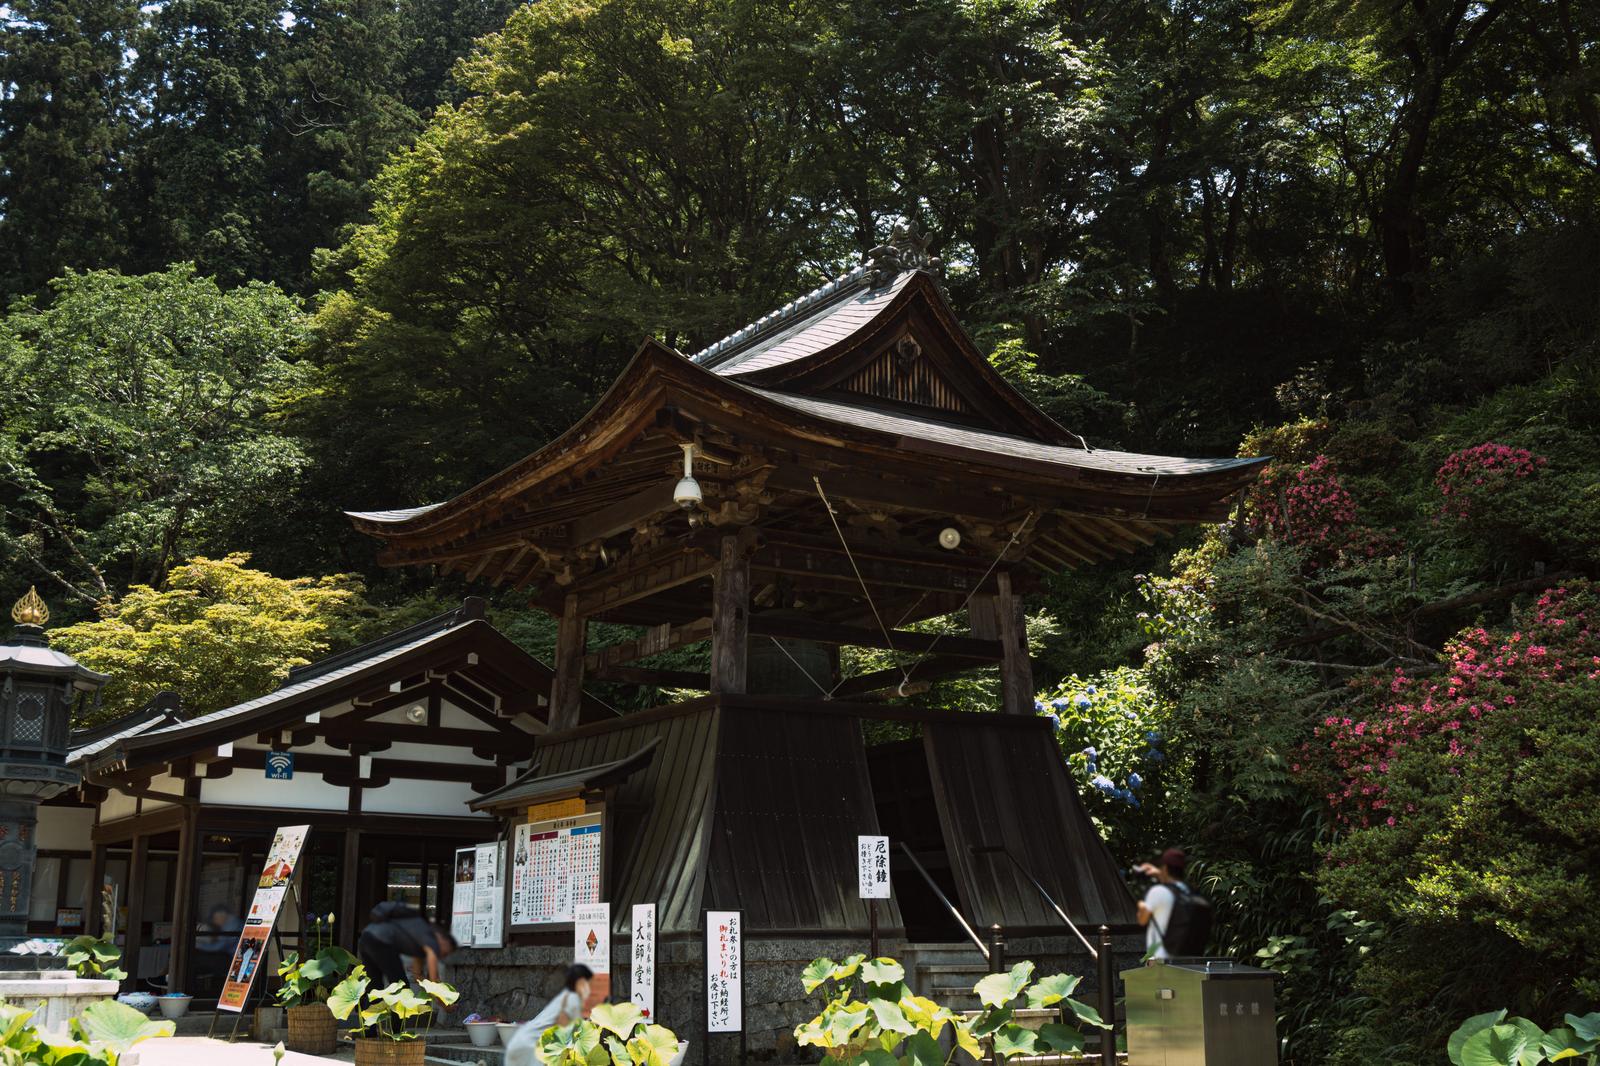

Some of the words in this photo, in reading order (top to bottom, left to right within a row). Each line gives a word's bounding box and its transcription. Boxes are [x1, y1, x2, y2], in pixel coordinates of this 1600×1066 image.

[875, 840, 887, 883] 厄除鐘
[710, 974, 720, 1027] お受け下さい
